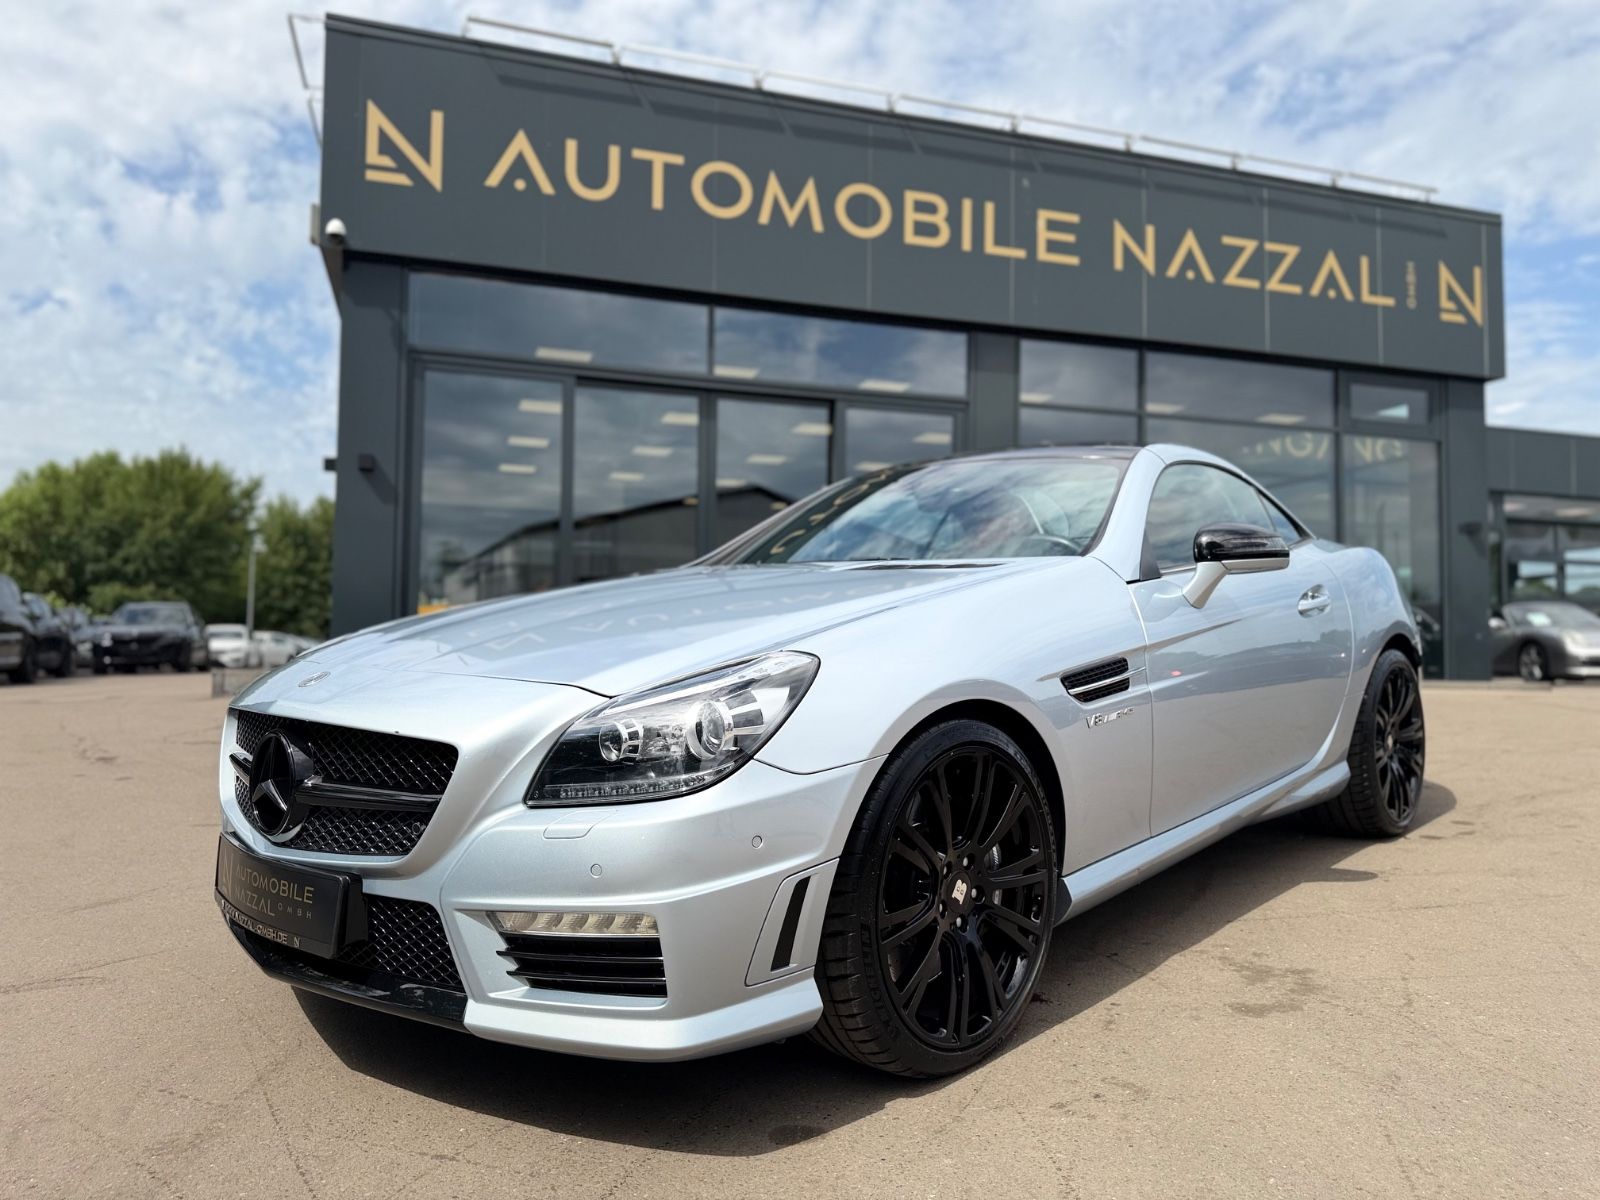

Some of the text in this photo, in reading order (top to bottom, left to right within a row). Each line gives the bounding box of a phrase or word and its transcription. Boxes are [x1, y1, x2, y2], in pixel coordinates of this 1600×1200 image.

[484, 130, 1082, 267] AUTOMOBILE
[1112, 220, 1397, 308] NAZZAL
[235, 863, 315, 904] AUTOMOBILE
[235, 887, 276, 917] NAZZAL
